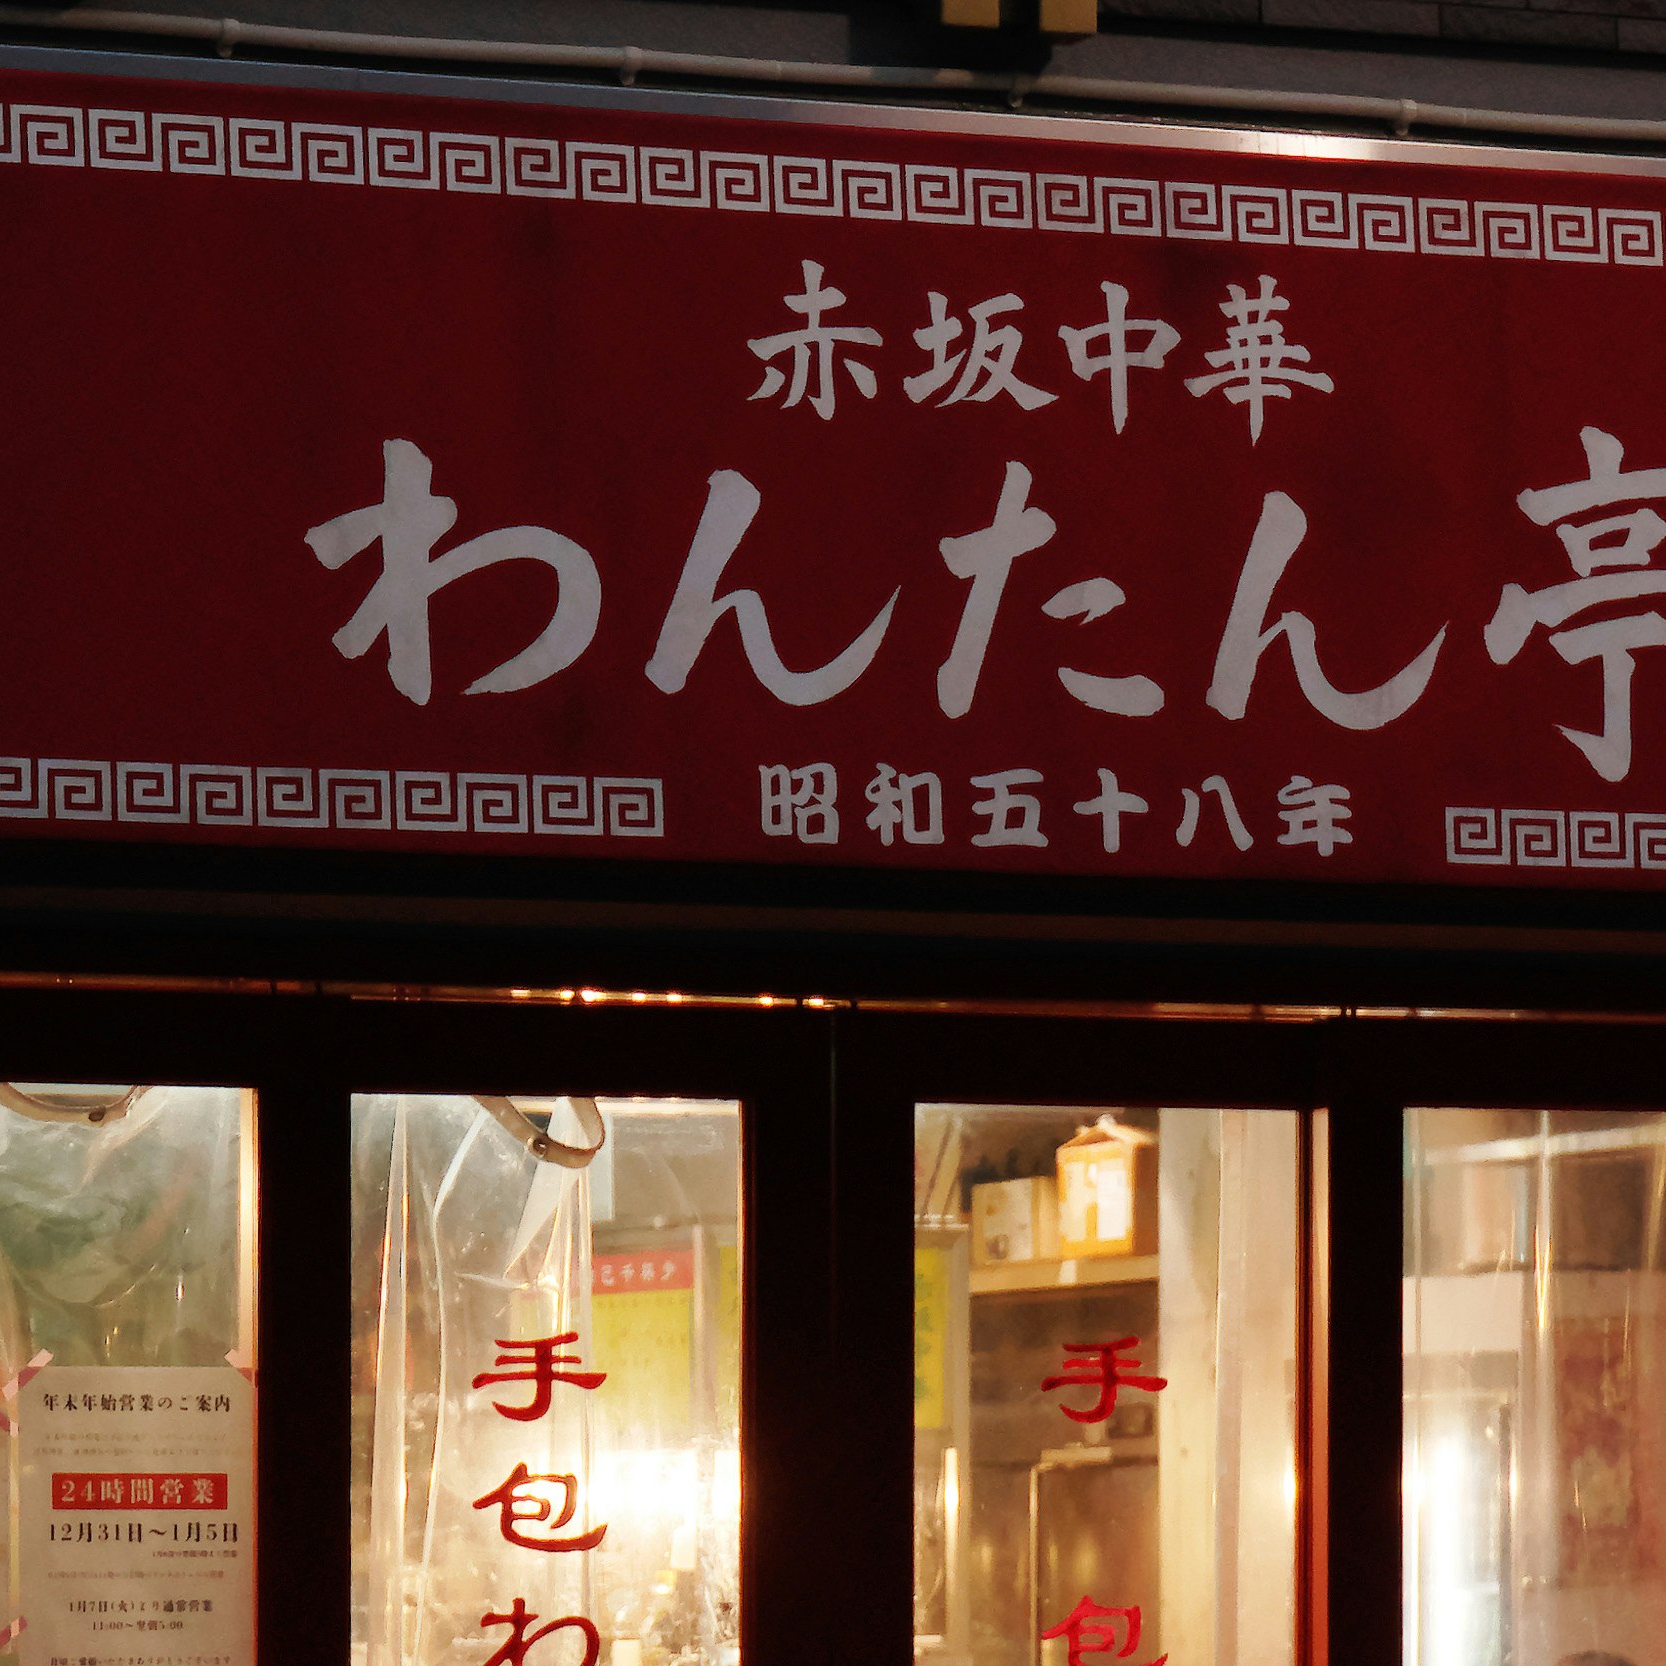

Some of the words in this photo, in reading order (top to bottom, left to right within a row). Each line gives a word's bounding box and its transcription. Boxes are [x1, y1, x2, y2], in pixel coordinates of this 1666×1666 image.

[745, 257, 1336, 447] 赤坂中華
[758, 762, 1354, 857] 昭和五十八年
[62, 1478, 213, 1504] 24時間営業
